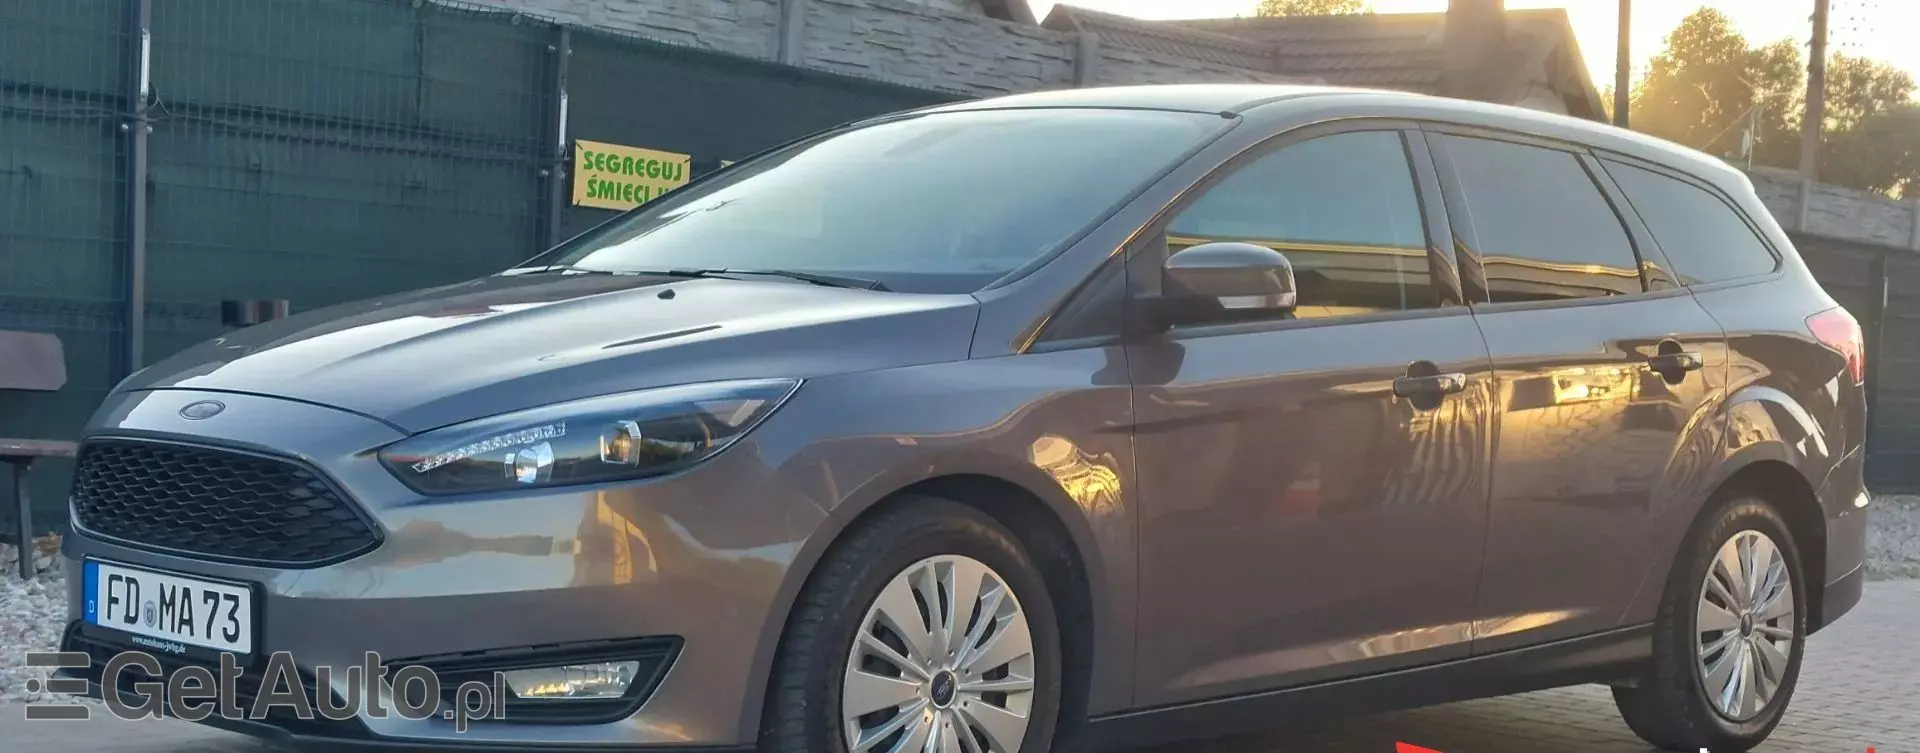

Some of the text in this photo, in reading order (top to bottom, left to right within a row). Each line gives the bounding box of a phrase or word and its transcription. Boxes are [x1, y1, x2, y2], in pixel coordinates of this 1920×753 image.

[583, 151, 682, 182] SEGREGUJ
[586, 174, 650, 204] ŚMIECI
[89, 599, 95, 614] D
[107, 574, 240, 643] FD MA 73
